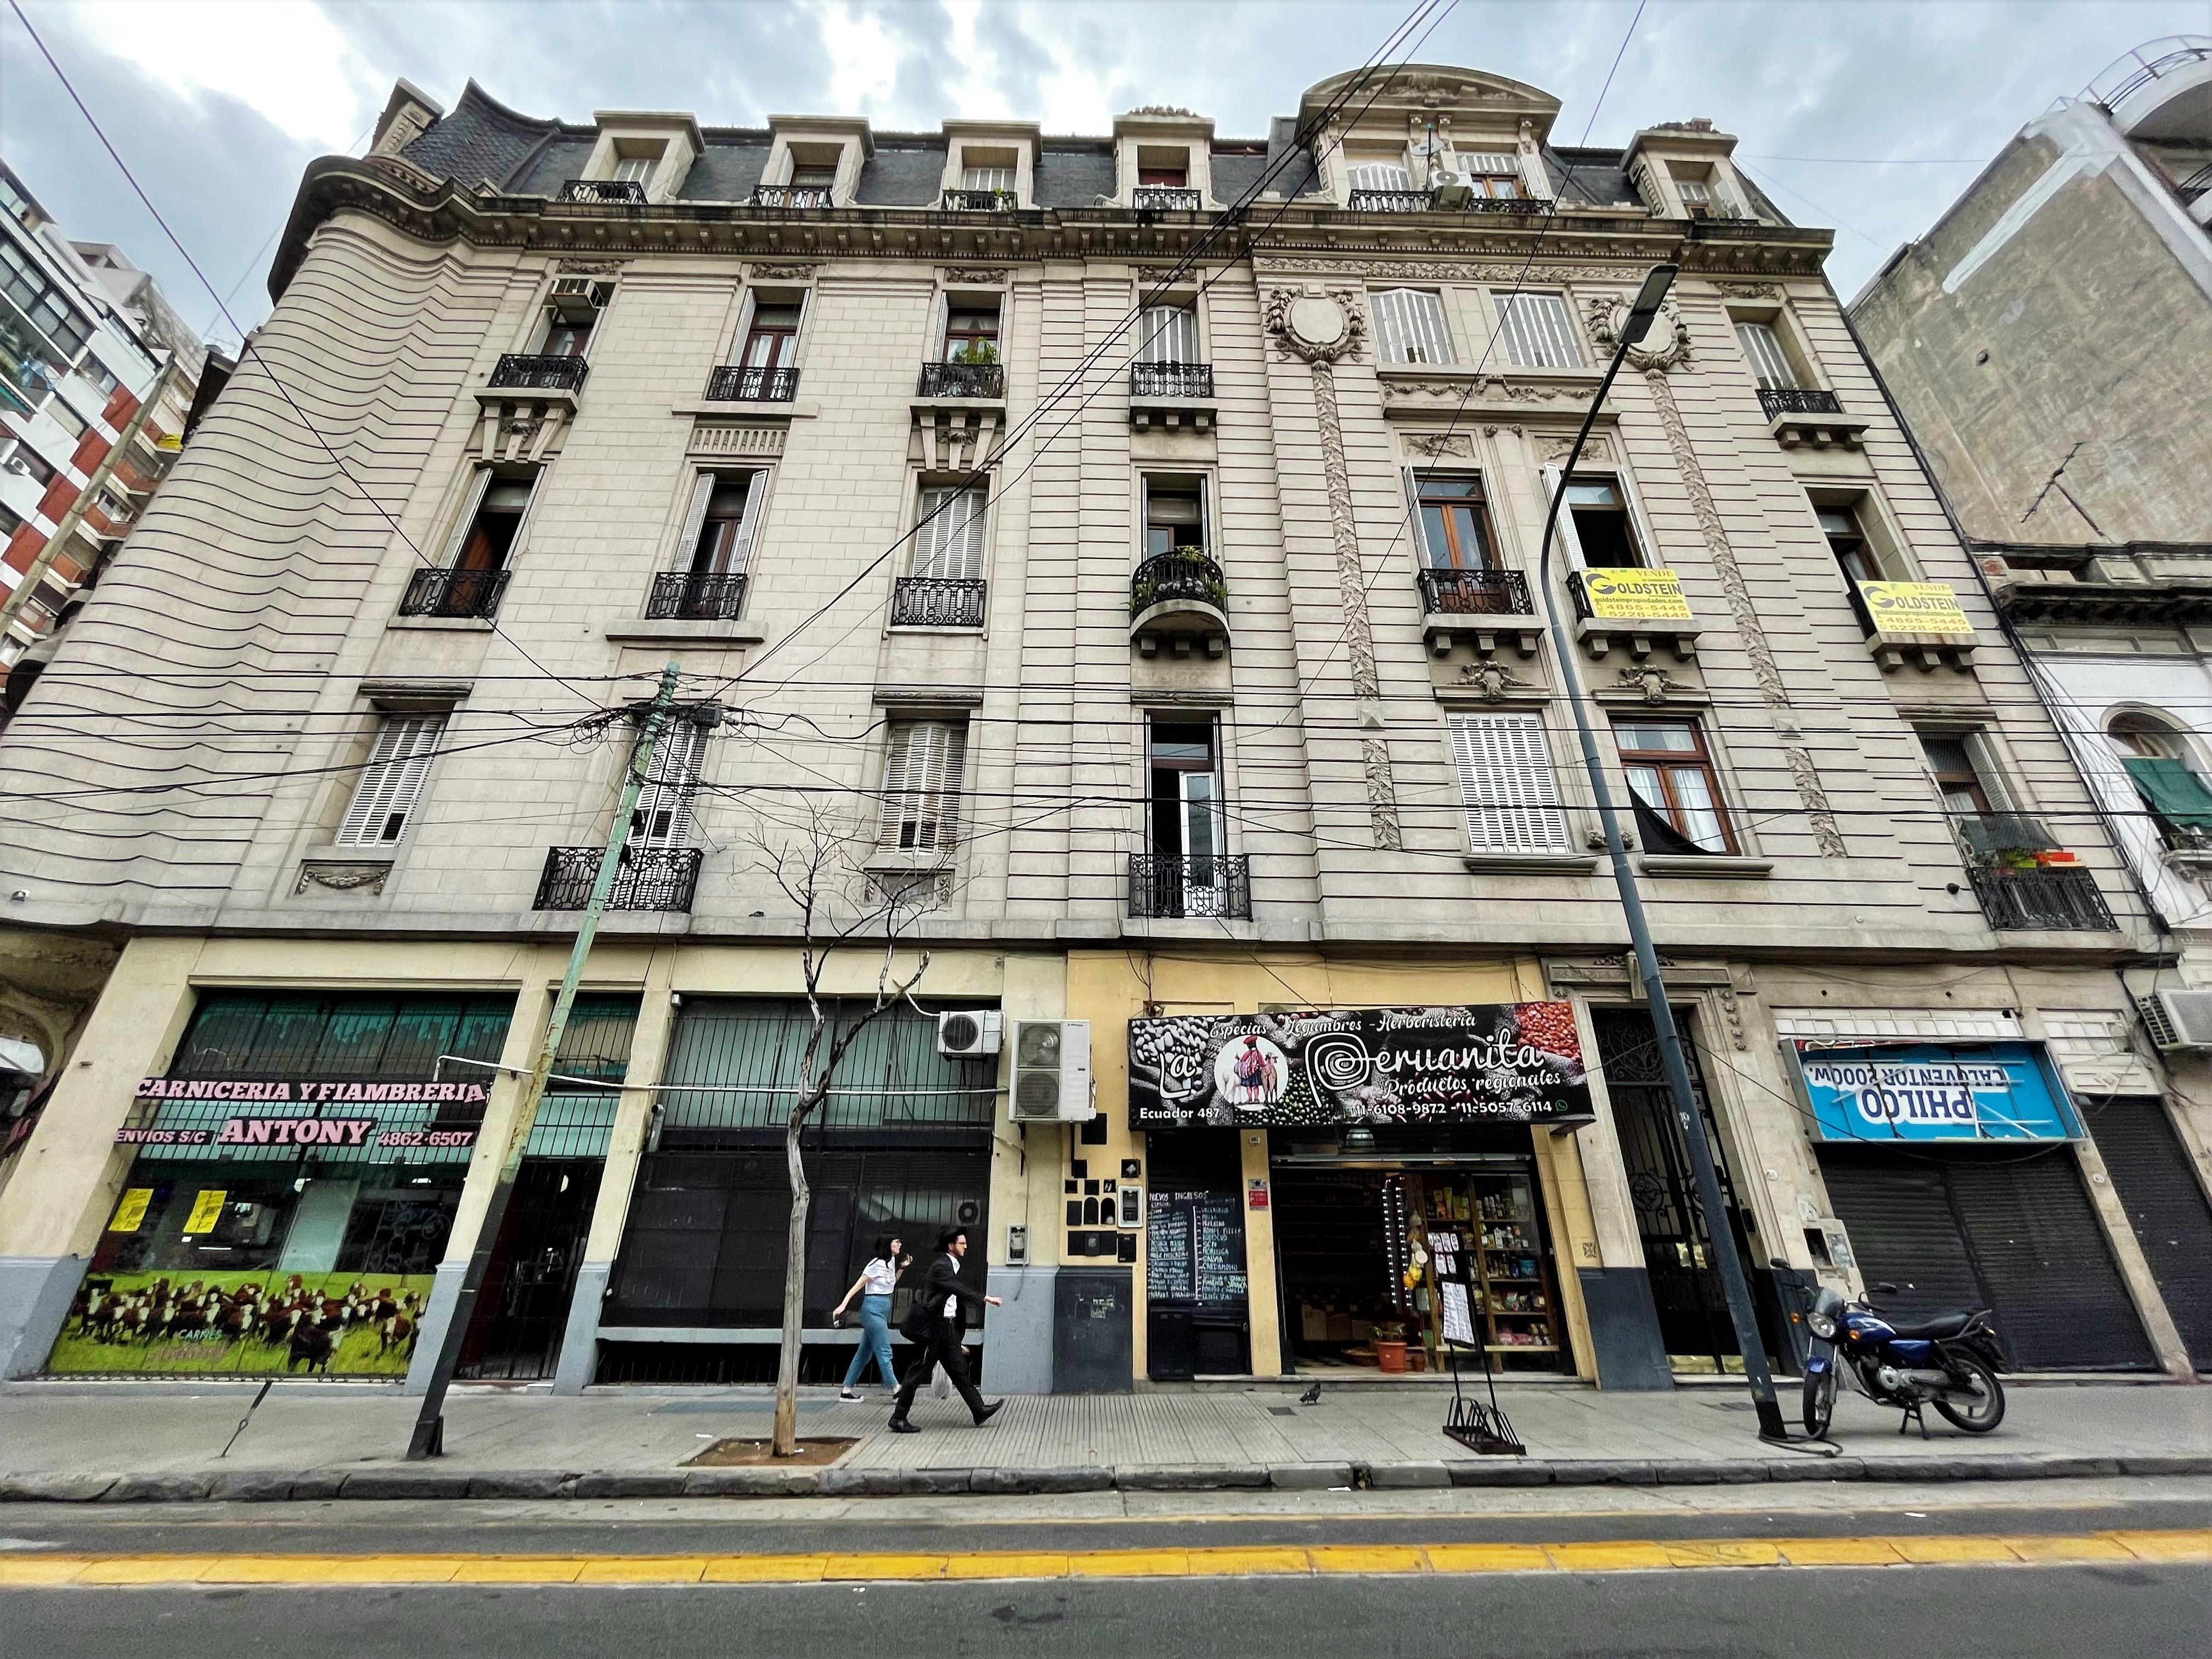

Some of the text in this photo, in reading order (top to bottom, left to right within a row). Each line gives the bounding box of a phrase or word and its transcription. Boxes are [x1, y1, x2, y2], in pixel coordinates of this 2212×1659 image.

[1210, 1022, 1267, 1039] Especias
[1285, 1019, 1362, 1036] Legumbres
[1159, 1028, 1544, 1108] La Peruanita
[135, 1079, 291, 1100] CARNICERIA
[316, 1083, 486, 1103] FIAMBRERIA
[1382, 1069, 1561, 1099] Productos regionales
[1140, 1107, 1221, 1119] Ecuador 487
[1356, 1103, 1447, 1116] 11-6108-9872
[1462, 1101, 1553, 1114] 11-5057-6114
[1861, 1088, 1973, 1119] PHILCO
[114, 1130, 175, 1143] ENVIOS
[178, 1131, 207, 1143] S/C
[218, 1119, 372, 1144] ANTONY
